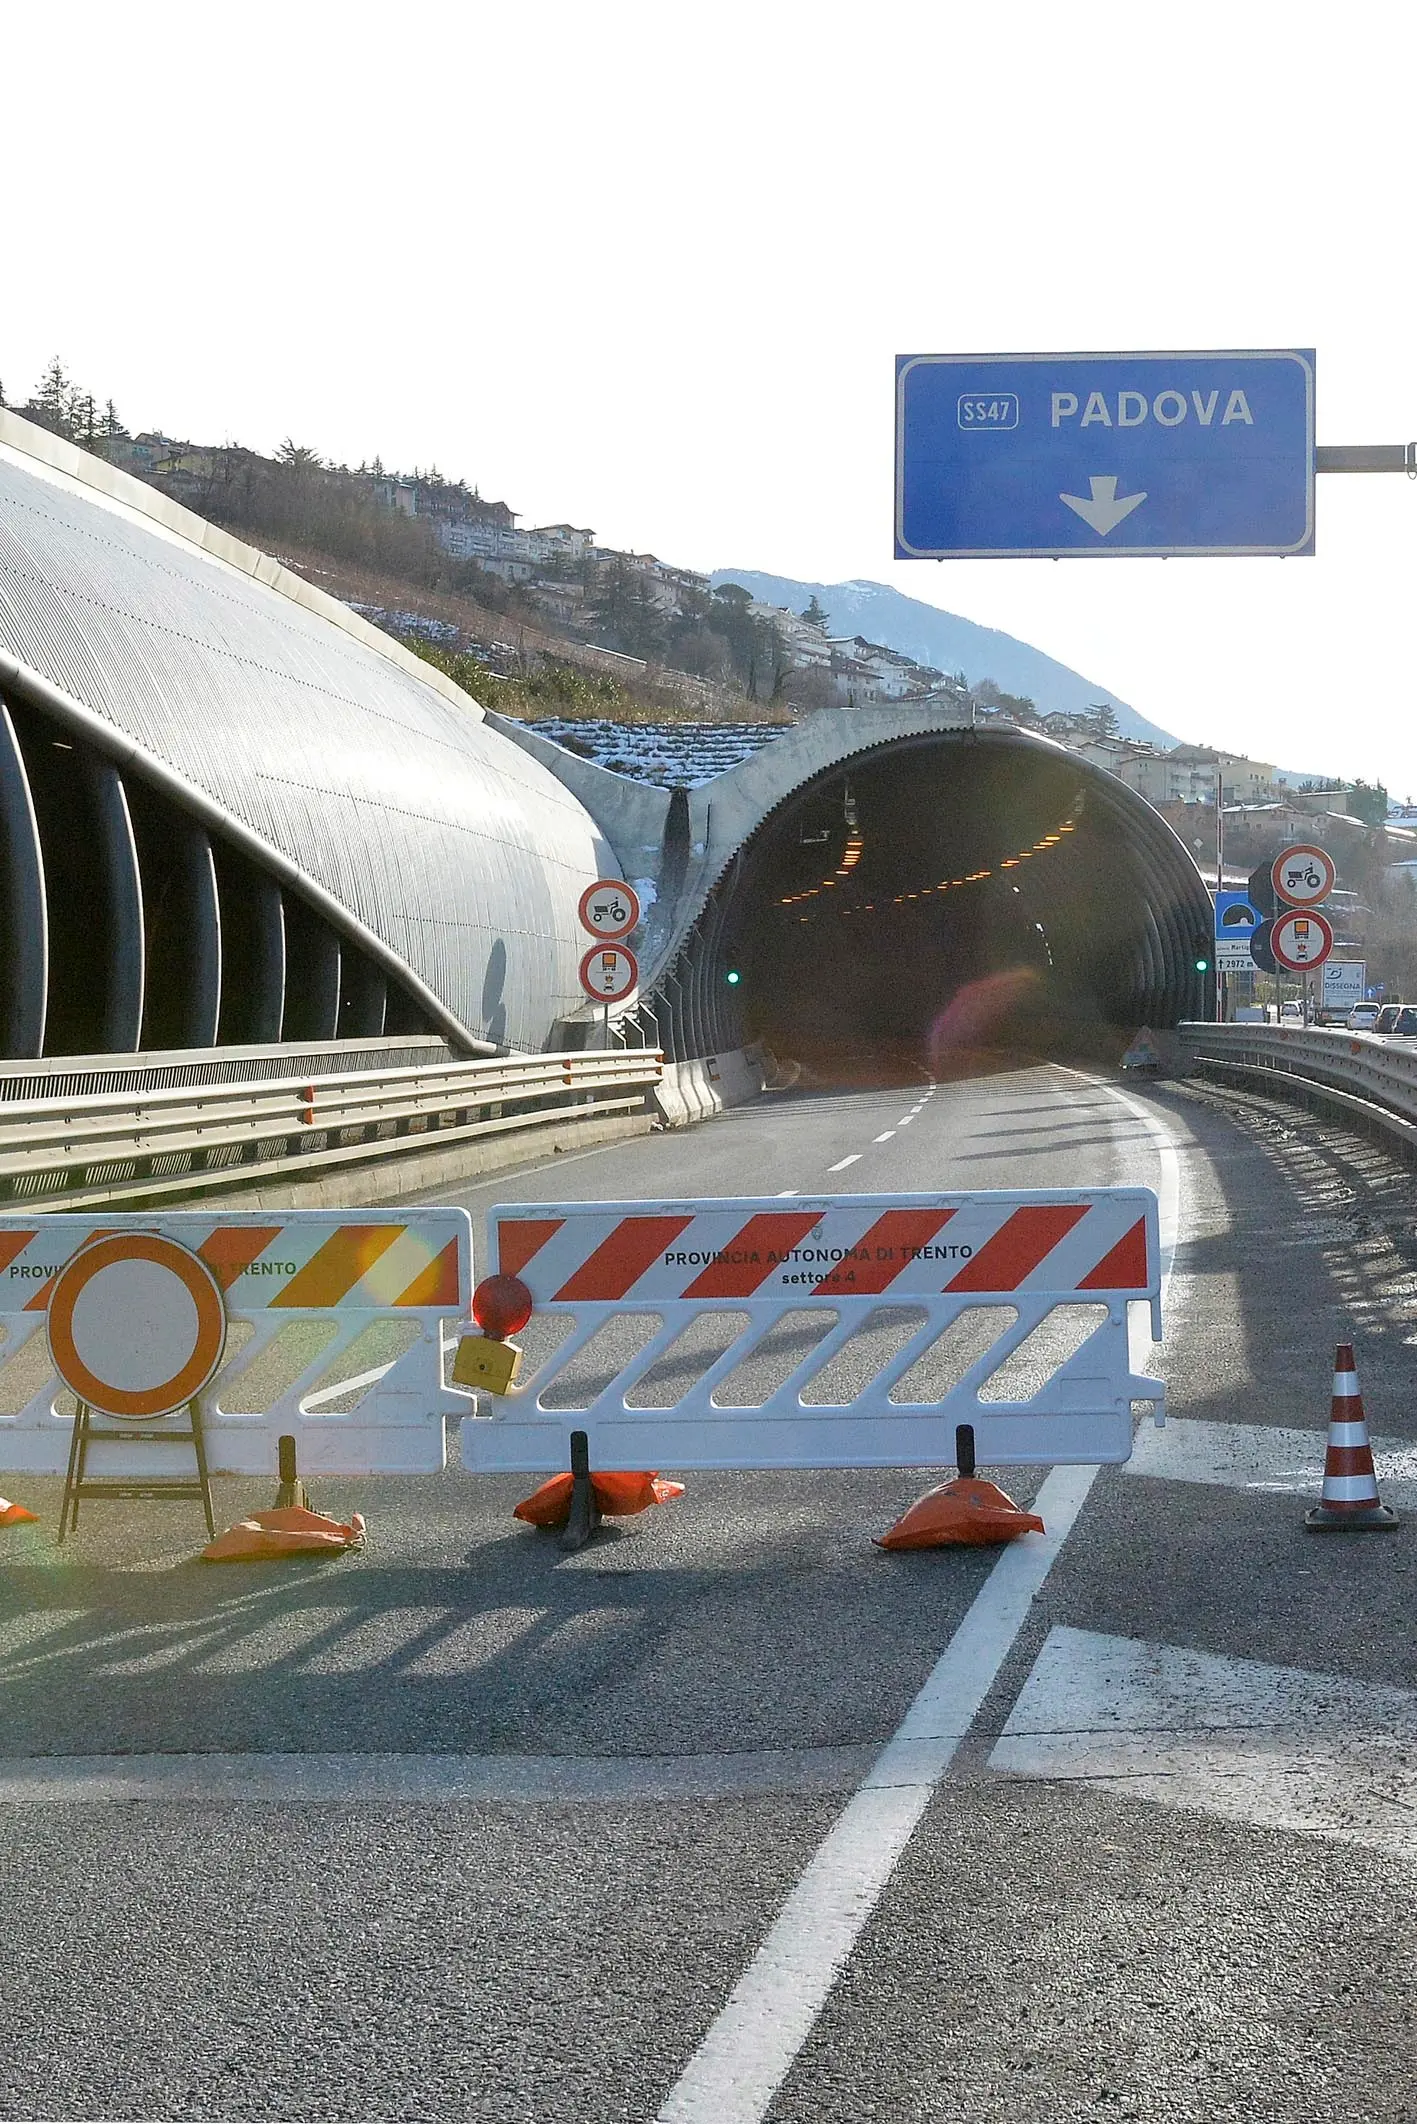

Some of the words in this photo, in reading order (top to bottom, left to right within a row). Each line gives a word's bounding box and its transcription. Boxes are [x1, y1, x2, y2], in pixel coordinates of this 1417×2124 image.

[963, 402, 1009, 421] SS47
[1051, 390, 1254, 428] PADOVA
[1226, 960, 1245, 968] 2972
[664, 1251, 761, 1265] PROVINCIA
[766, 1248, 871, 1263] AUTONOMA
[876, 1247, 894, 1261] DI
[902, 1245, 973, 1260] TRENTO
[782, 1271, 841, 1284] settore
